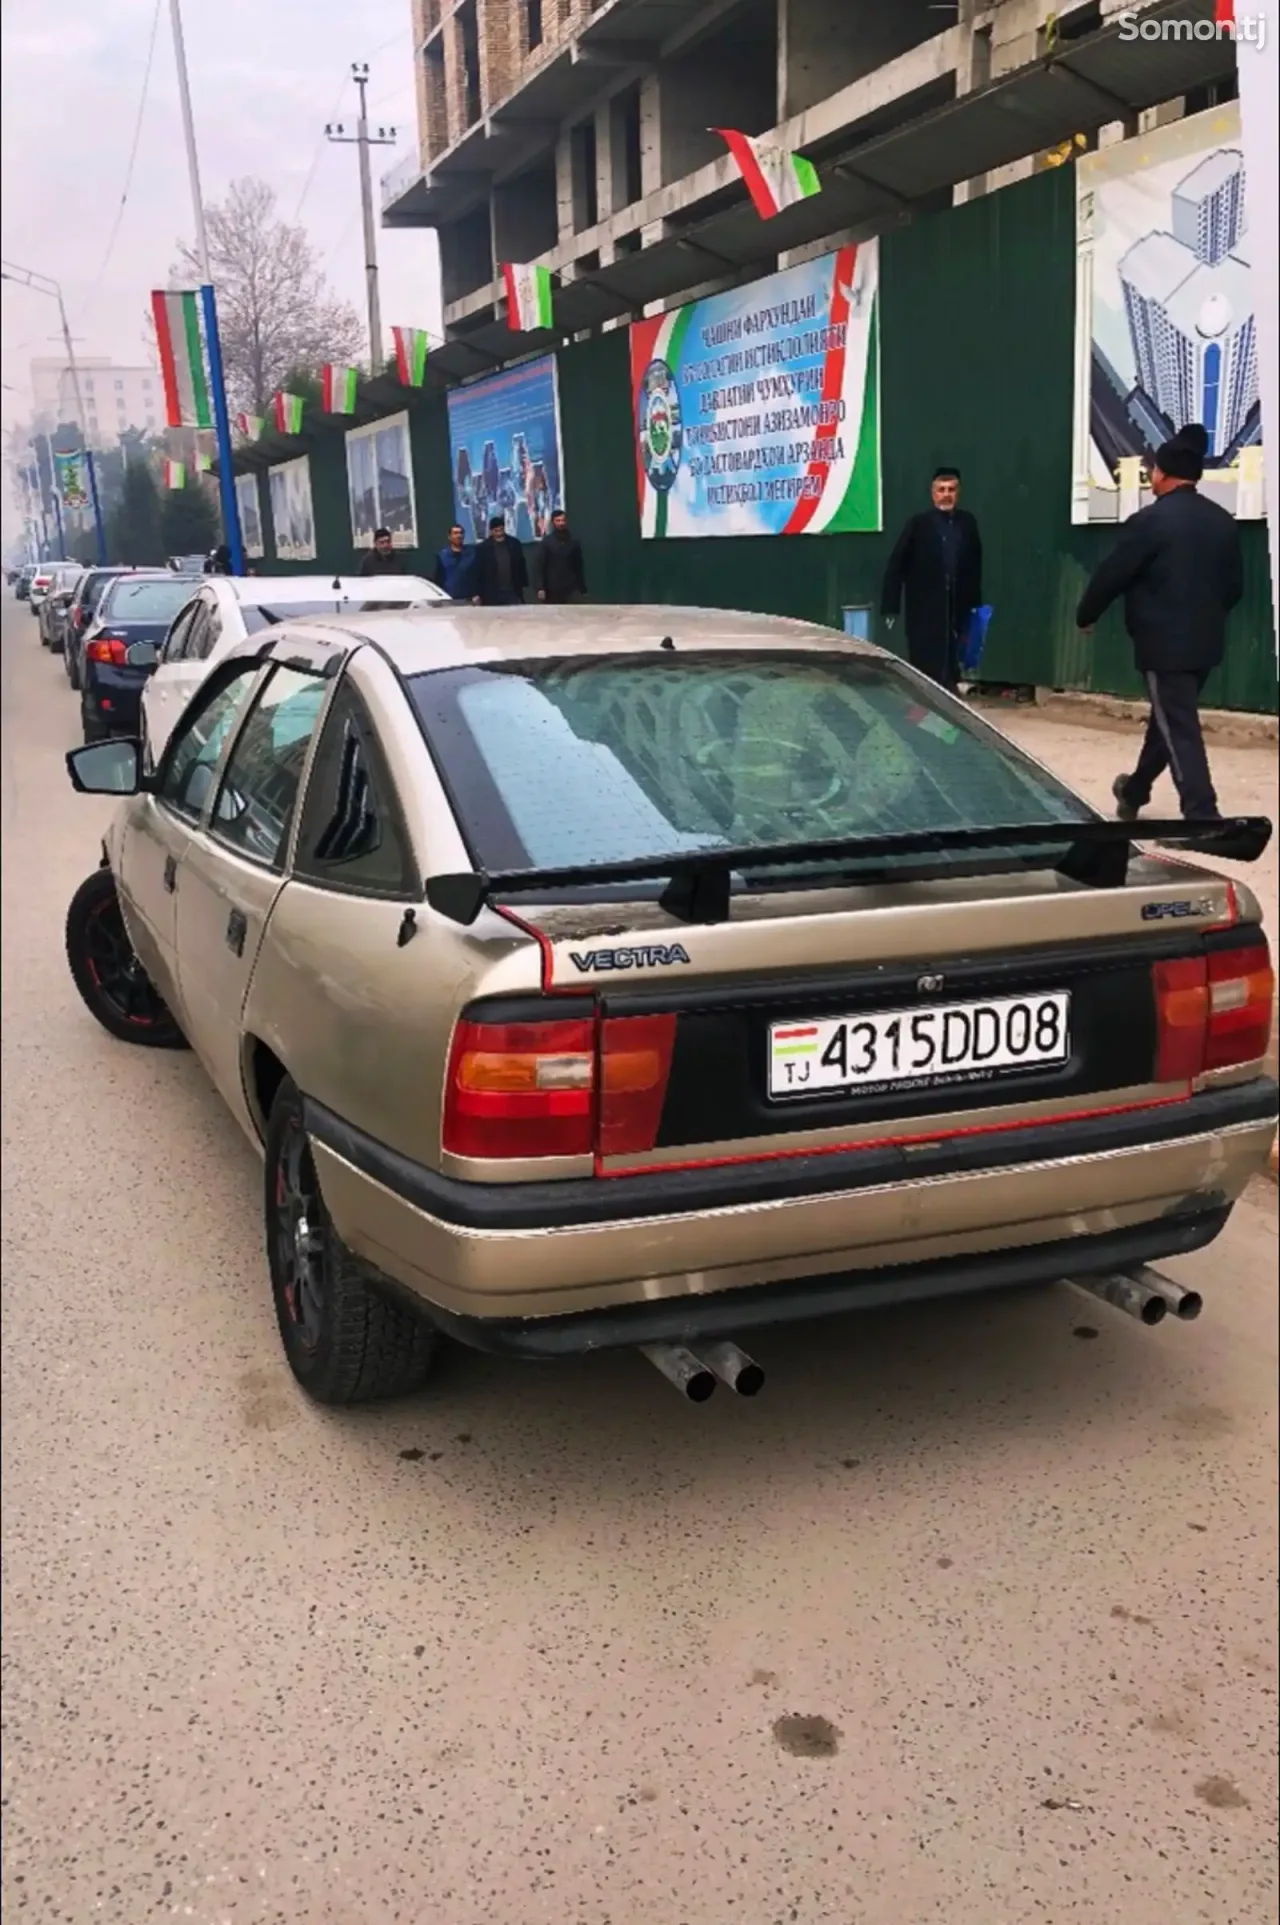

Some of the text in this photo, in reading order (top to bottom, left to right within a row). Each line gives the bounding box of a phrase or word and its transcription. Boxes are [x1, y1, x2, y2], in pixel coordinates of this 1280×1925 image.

[569, 943, 690, 973] VECTRA
[821, 1001, 1060, 1078] 4315DD08
[785, 1061, 810, 1084] TJ
